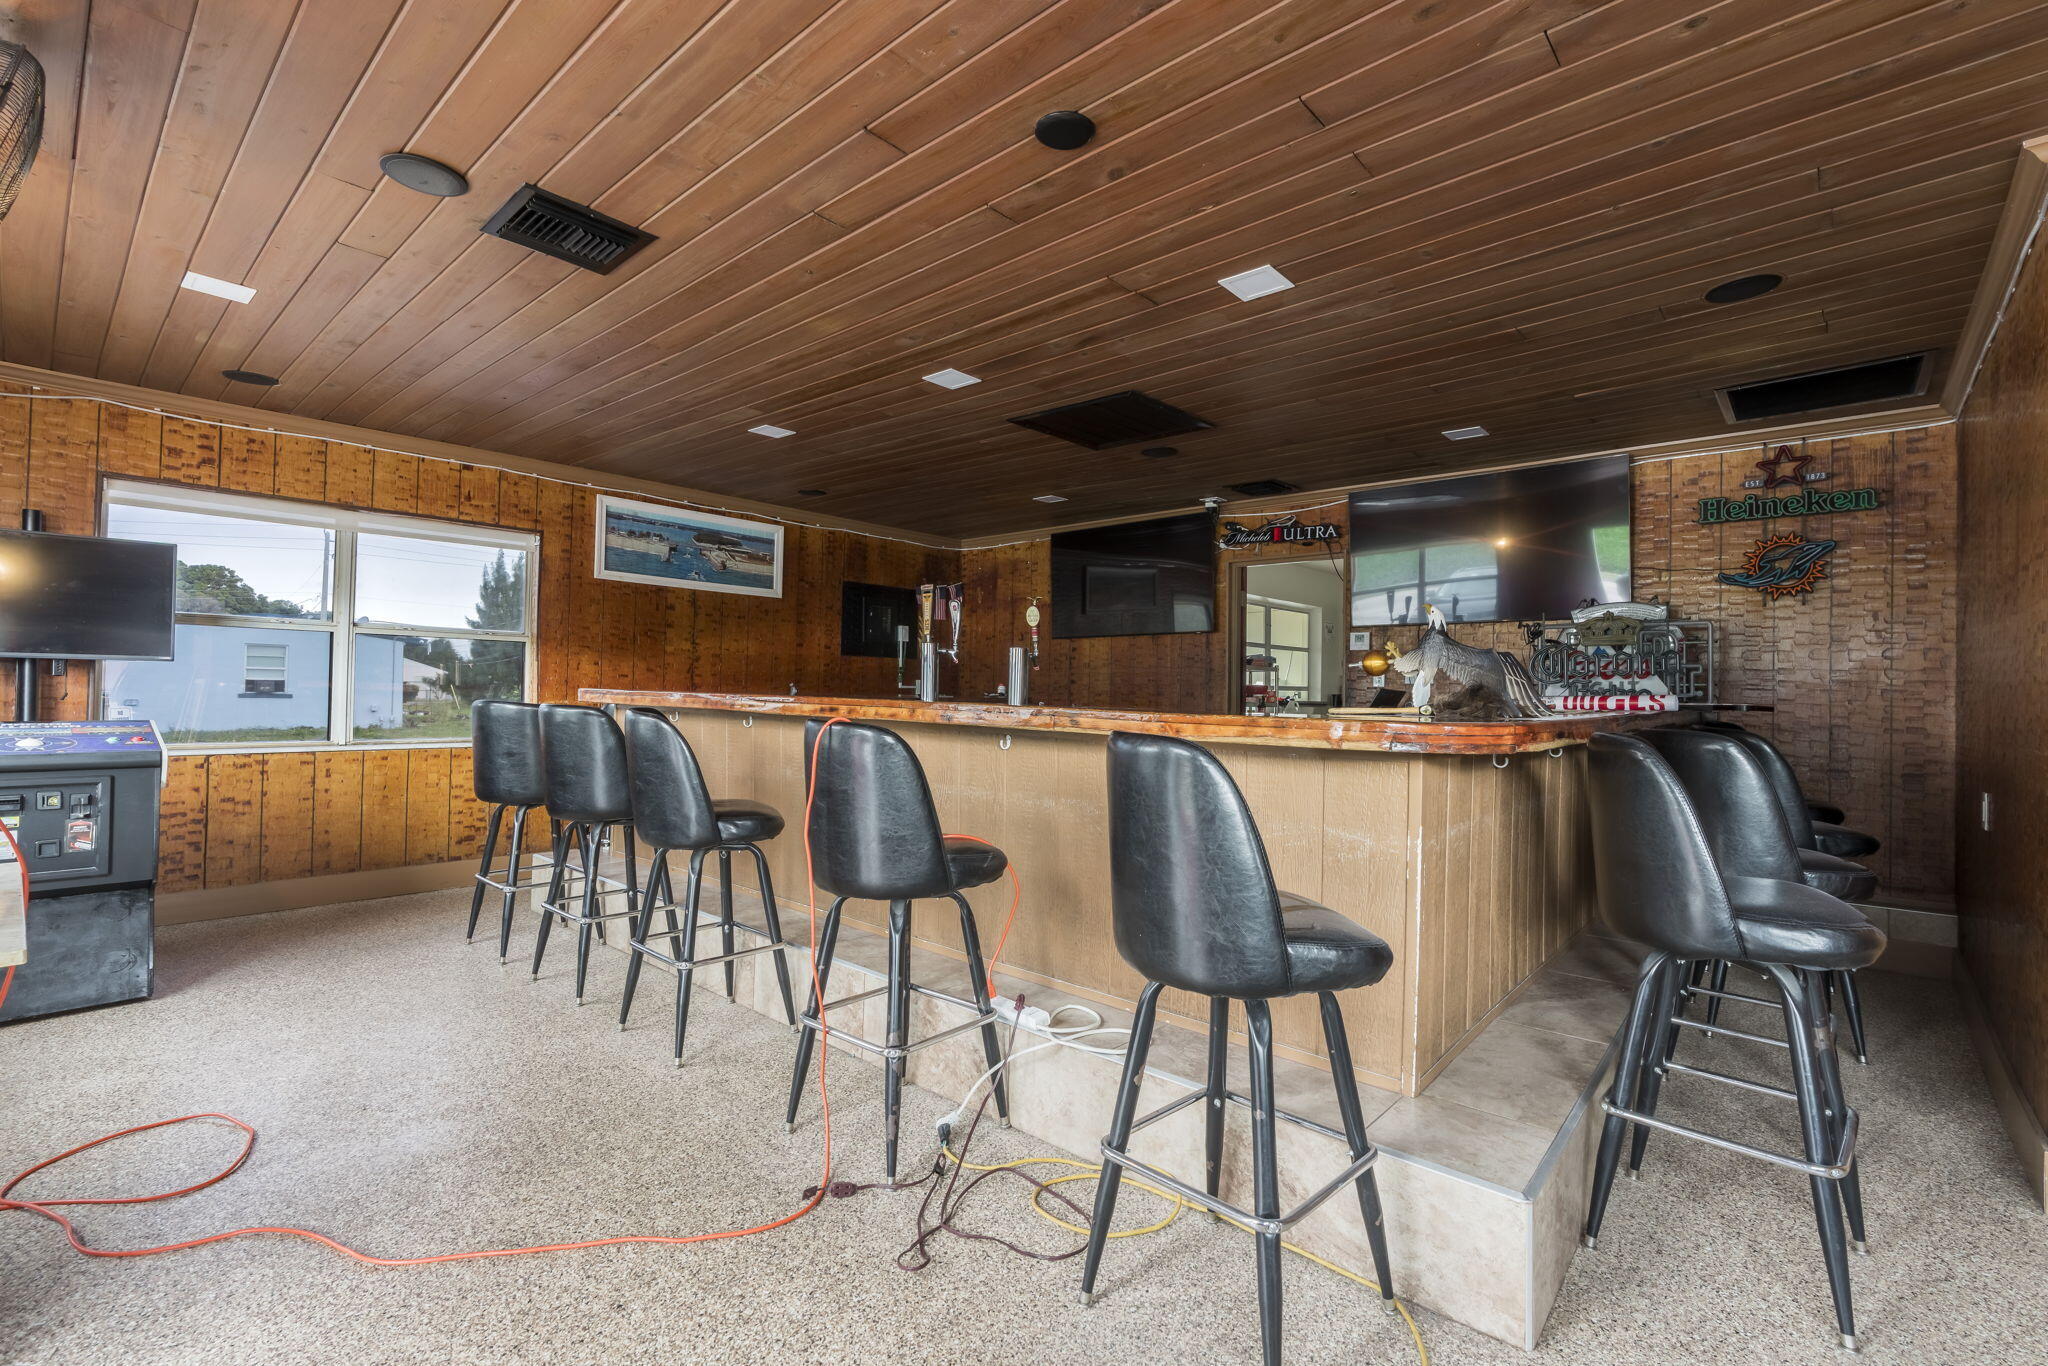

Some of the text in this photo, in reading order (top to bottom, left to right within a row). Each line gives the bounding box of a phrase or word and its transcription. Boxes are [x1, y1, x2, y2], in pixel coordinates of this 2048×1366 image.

[1807, 472, 1826, 480] 1873
[1699, 489, 1878, 523] Heineken
[1283, 525, 1337, 540] ULTRA
[1530, 644, 1681, 687] Corona
